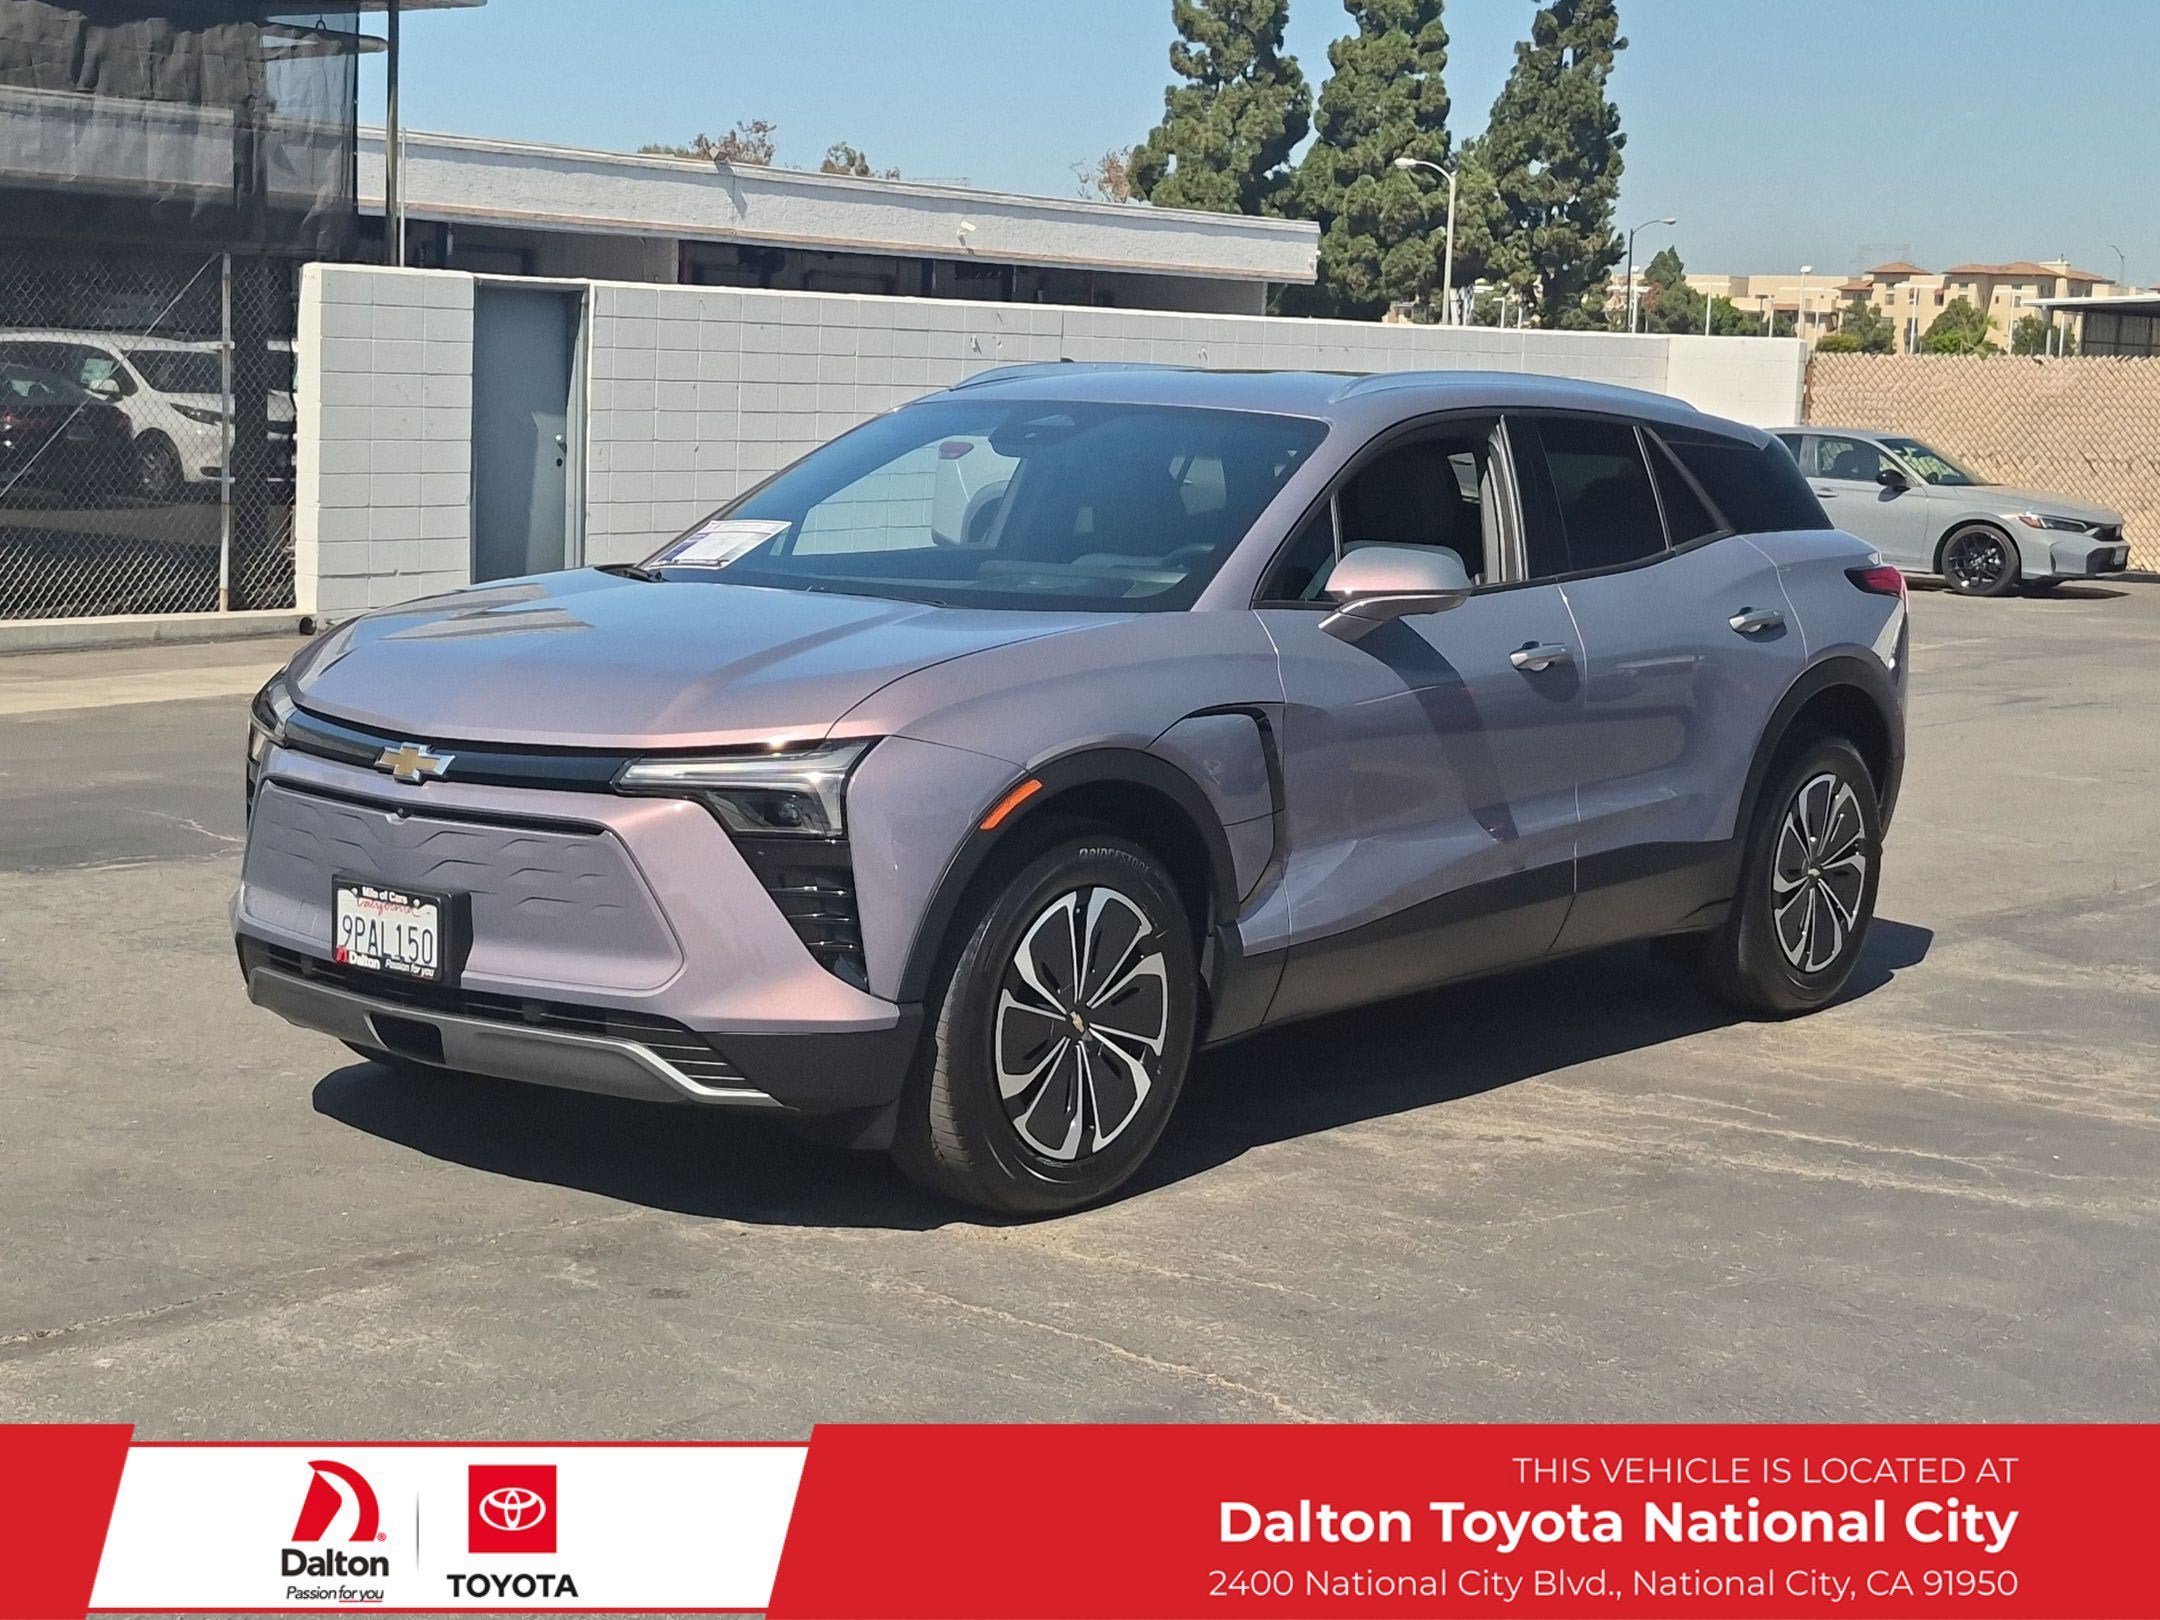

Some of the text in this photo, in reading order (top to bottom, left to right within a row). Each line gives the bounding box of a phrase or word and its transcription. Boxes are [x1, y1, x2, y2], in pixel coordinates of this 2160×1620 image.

[379, 889, 388, 900] of
[389, 892, 408, 904] Cars
[342, 915, 433, 964] 9PAL150
[348, 951, 380, 970] Dalton
[411, 963, 420, 974] for
[420, 967, 435, 977] you
